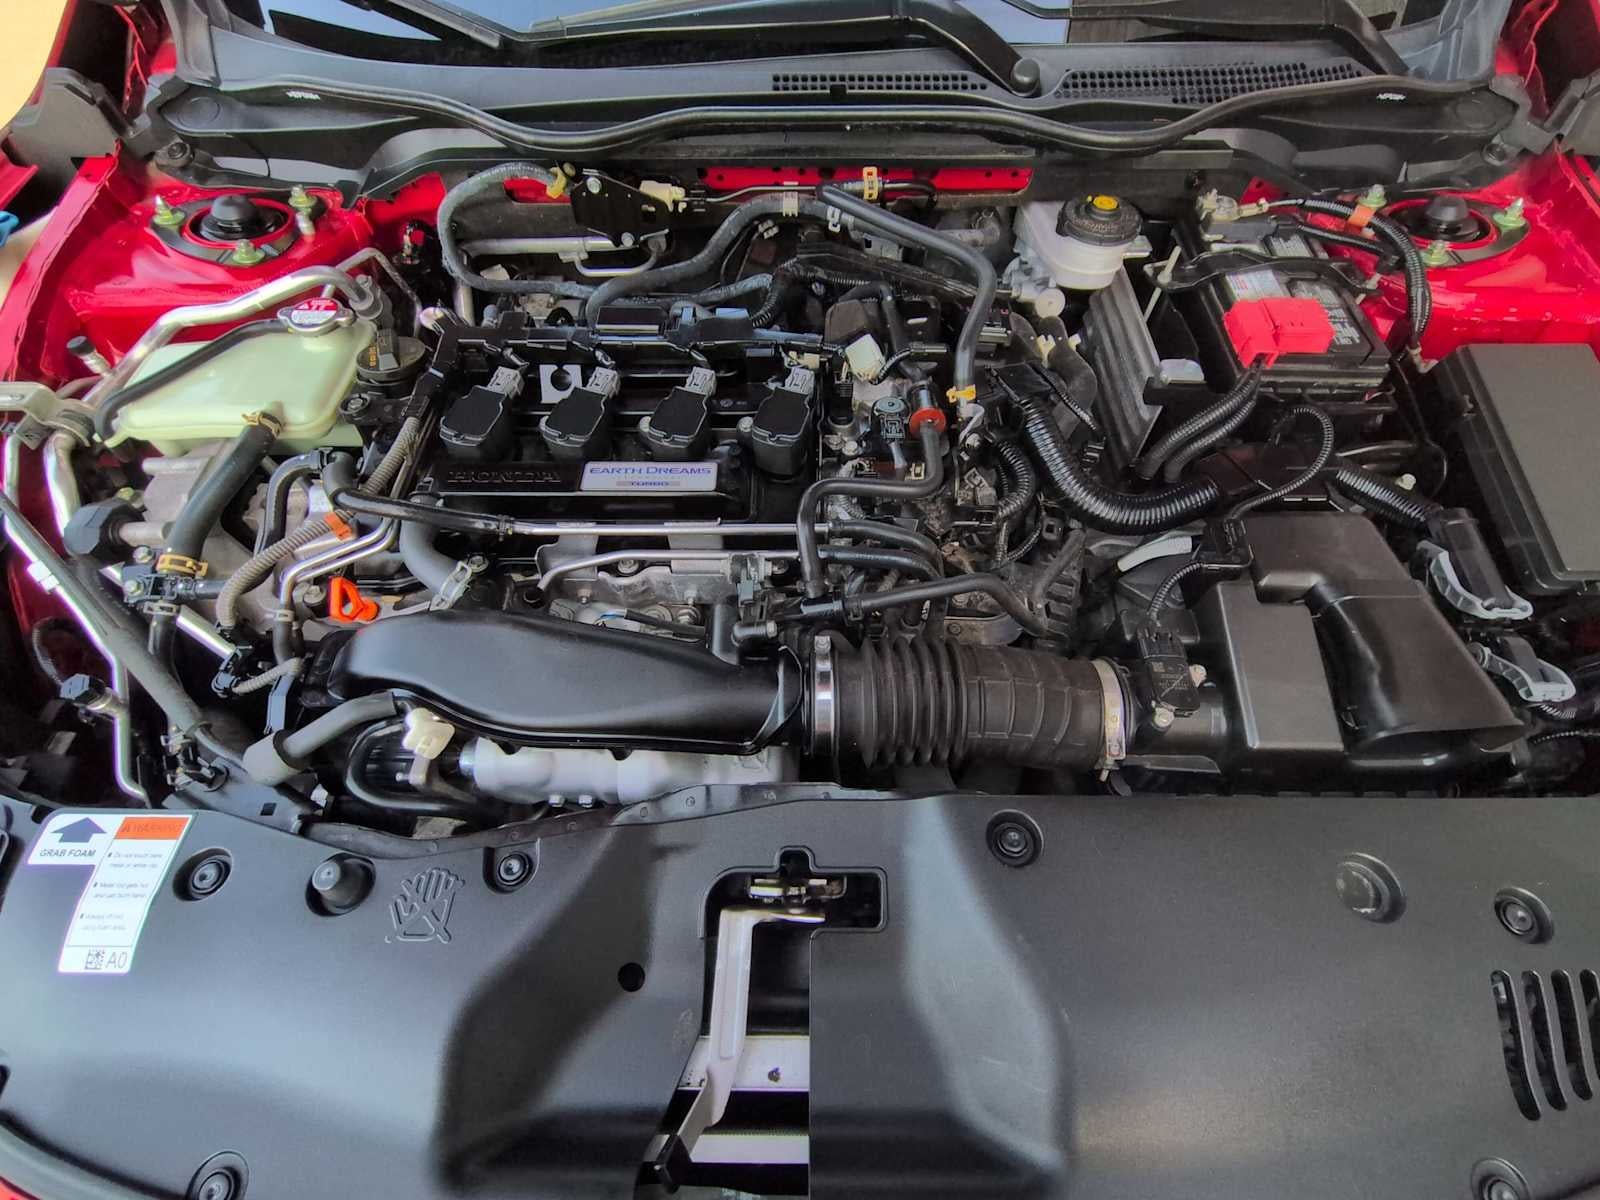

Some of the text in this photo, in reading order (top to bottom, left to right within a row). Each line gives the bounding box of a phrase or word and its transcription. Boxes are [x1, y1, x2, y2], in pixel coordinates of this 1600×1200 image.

[589, 466, 713, 475] EARTH DREAMS
[39, 849, 96, 858] GRAB FOAM
